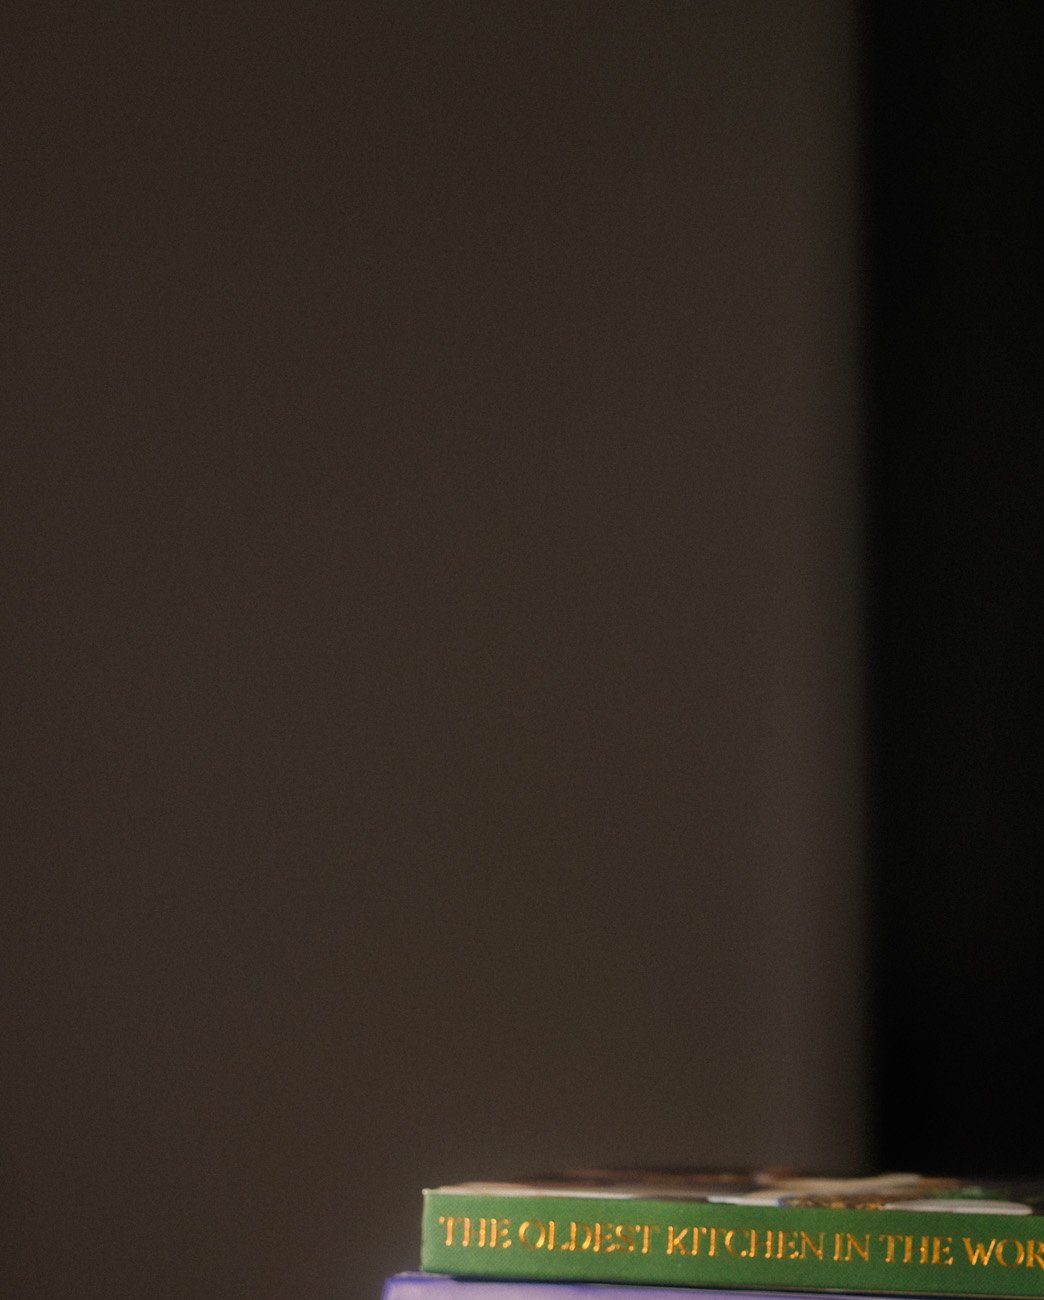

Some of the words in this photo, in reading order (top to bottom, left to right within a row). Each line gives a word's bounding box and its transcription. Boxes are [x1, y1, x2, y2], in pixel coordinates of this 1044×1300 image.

[438, 1216, 512, 1249] THE
[518, 1219, 660, 1255] OLDEST
[666, 1225, 824, 1260] KITCHEN
[833, 1232, 870, 1263] IN
[880, 1235, 953, 1266] THE
